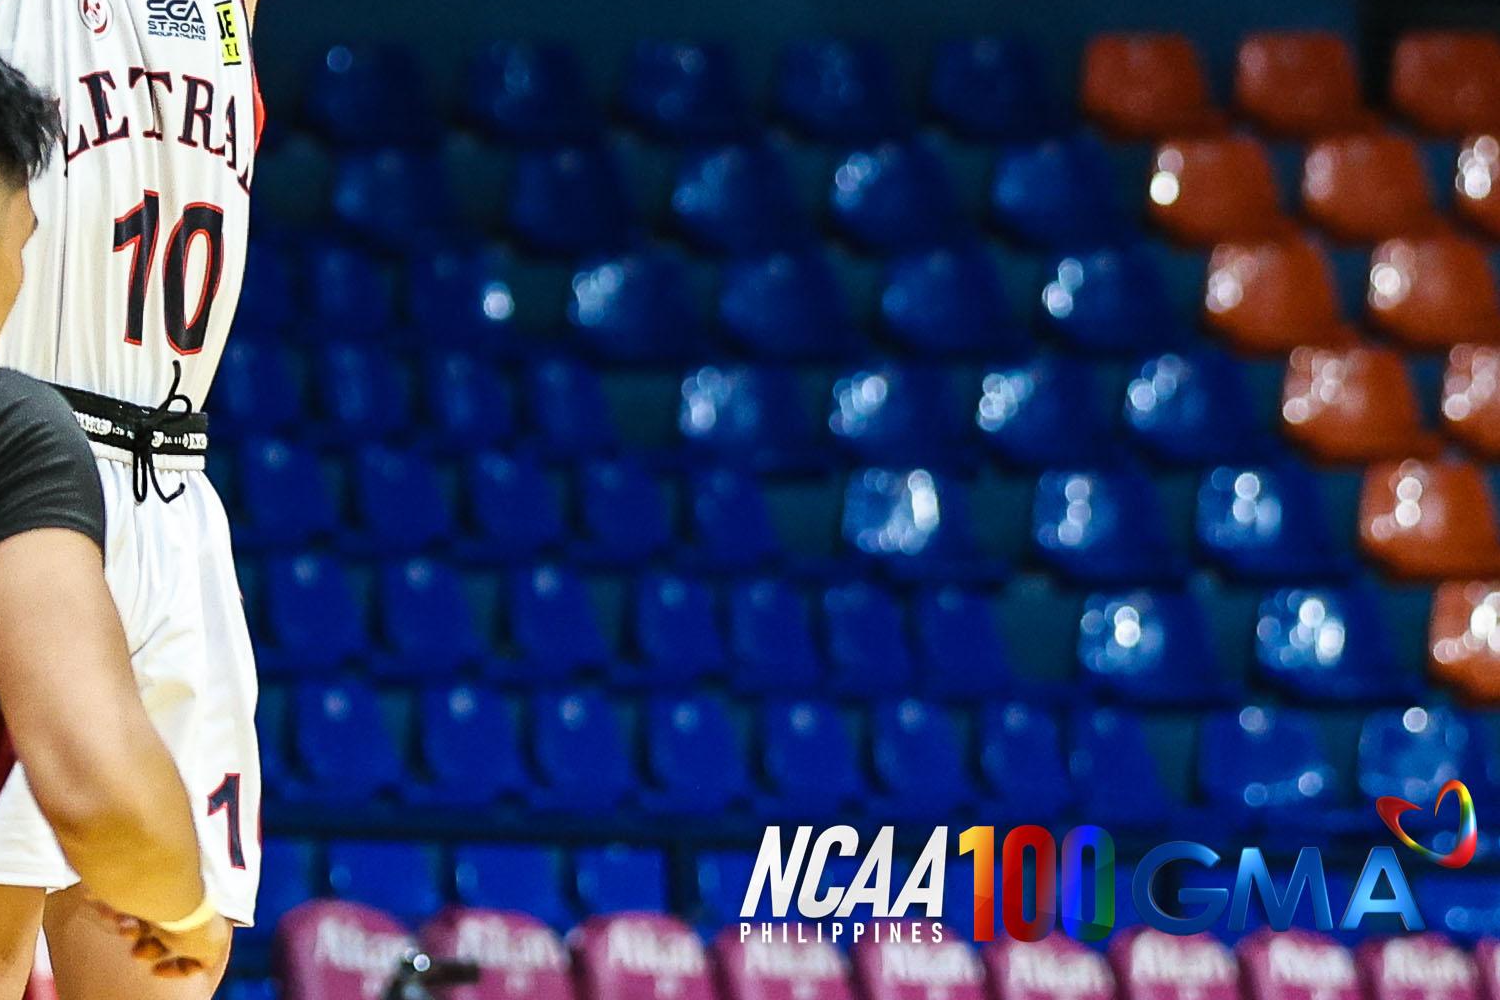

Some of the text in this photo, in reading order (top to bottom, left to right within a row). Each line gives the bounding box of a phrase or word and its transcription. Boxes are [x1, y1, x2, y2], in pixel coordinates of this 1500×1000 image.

[147, 19, 206, 36] STRONG
[67, 66, 250, 196] ETRA
[113, 189, 224, 356] 10
[206, 772, 247, 871] 1
